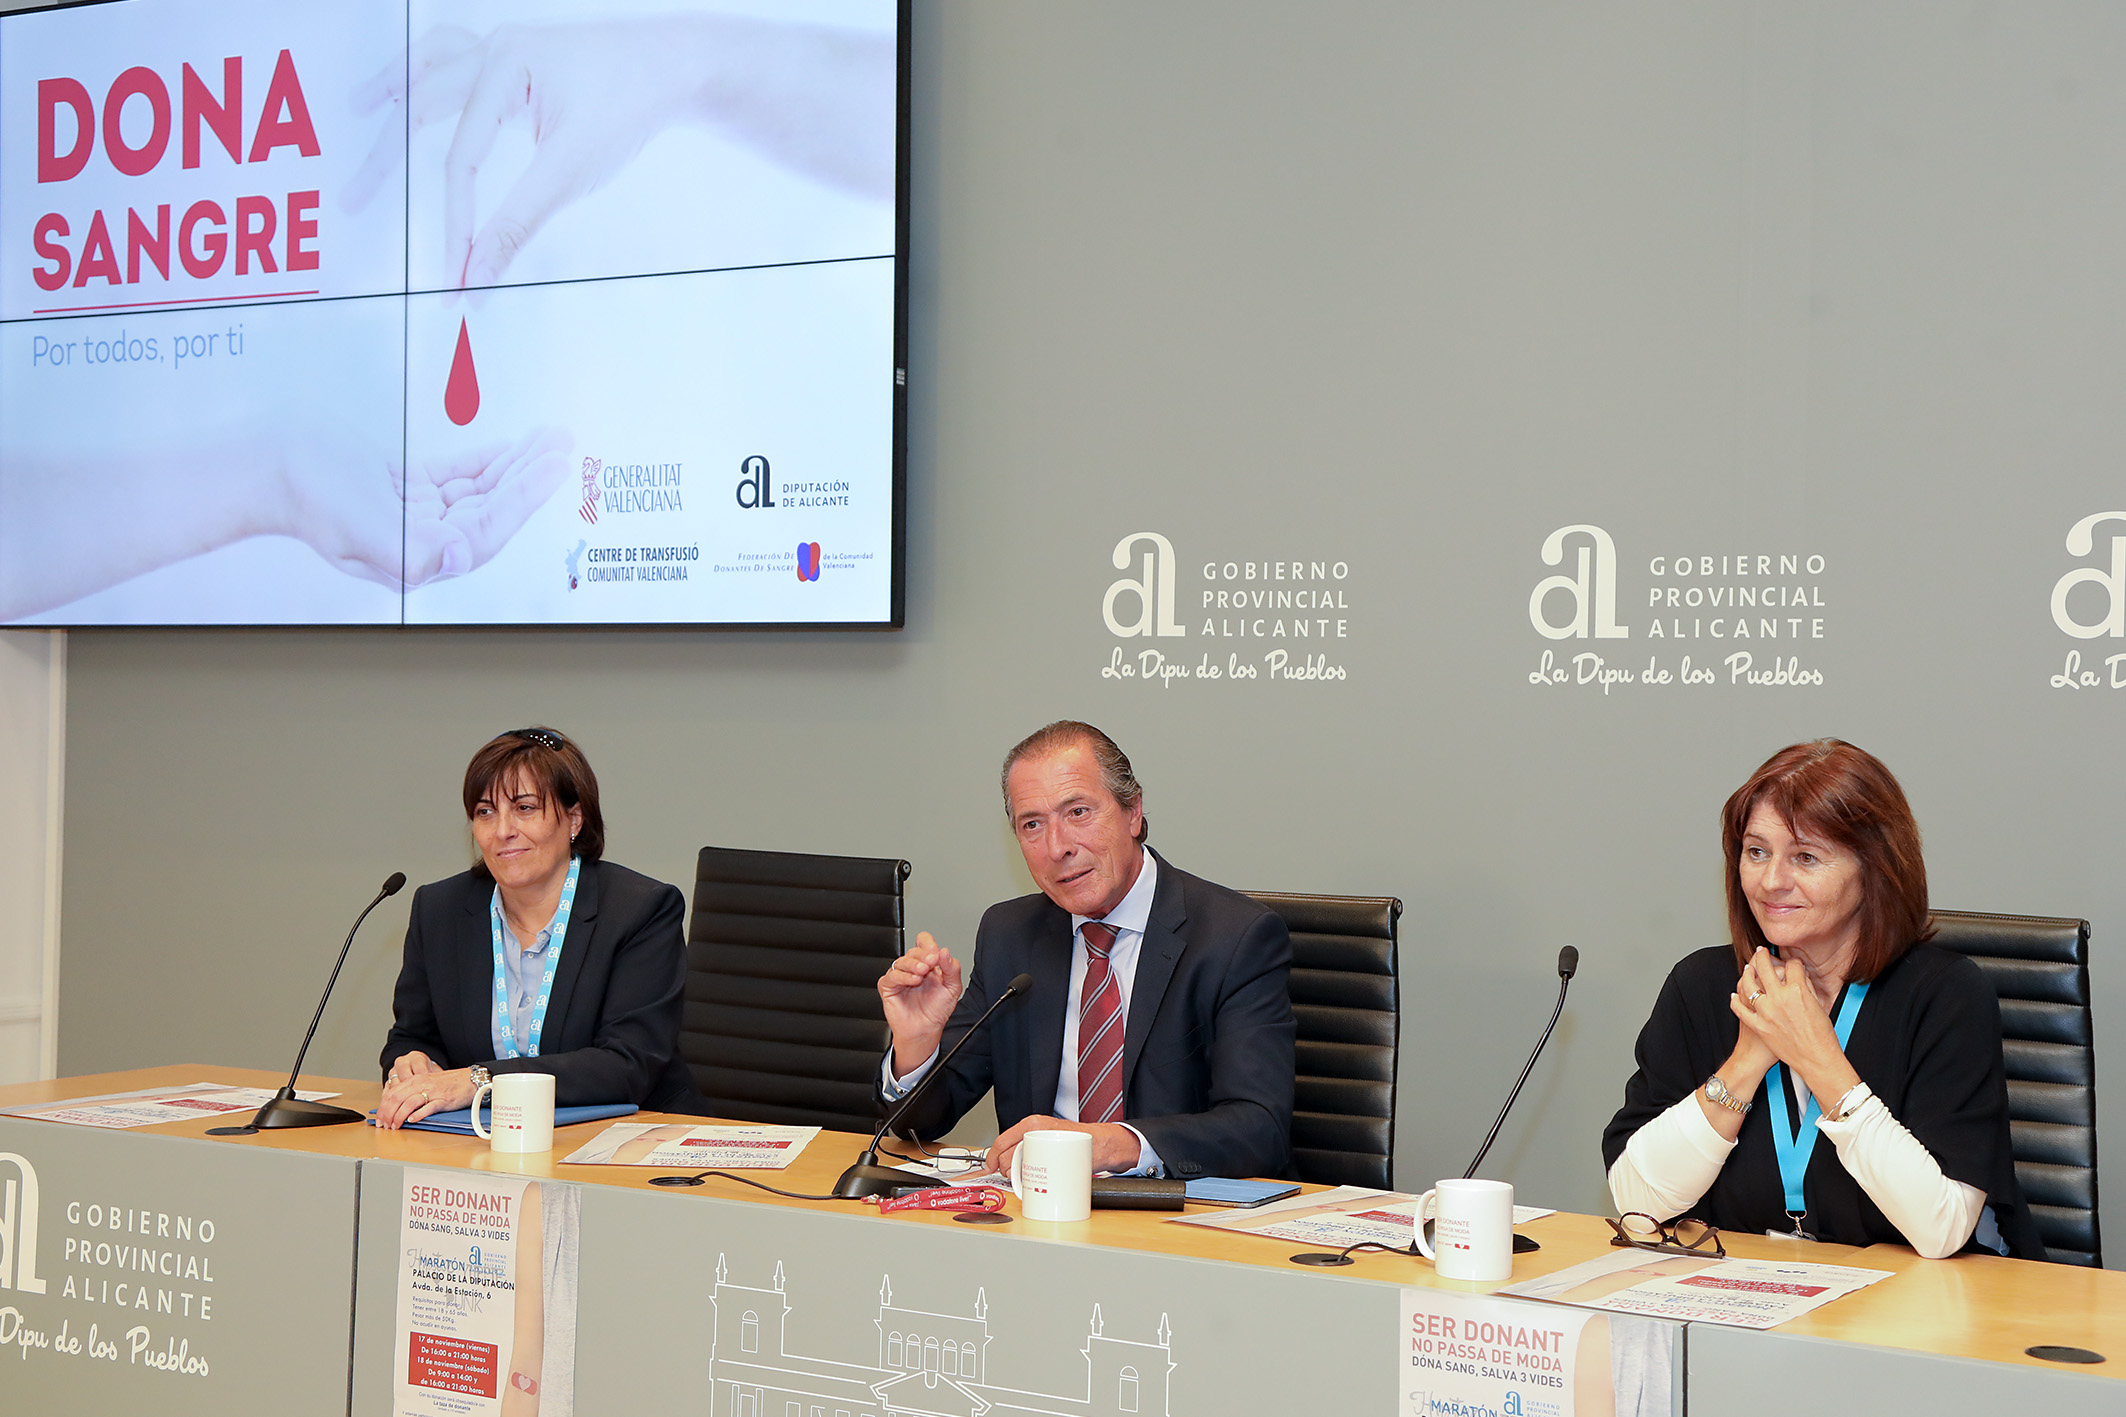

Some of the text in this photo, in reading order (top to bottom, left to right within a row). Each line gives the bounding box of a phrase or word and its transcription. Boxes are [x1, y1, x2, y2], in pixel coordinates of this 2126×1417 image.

[38, 49, 321, 183] DONA
[33, 190, 319, 291] SANGRE
[33, 324, 243, 368] Por todos, por ti
[604, 464, 683, 488] GENERALITAT
[783, 481, 849, 493] DIPUTACIÓN
[604, 490, 682, 512] VALENCIANA
[783, 496, 848, 507] DE ALICANTE
[588, 542, 699, 562] CENTRE DE TRANSFUSIÓ
[587, 566, 687, 582] COMUNITAT VALENCIANA
[1203, 562, 1348, 580] GOBIERNO
[1650, 555, 1825, 576] GOBIERNO
[1203, 590, 1348, 608] PROVINCIAL
[1649, 587, 1825, 607] PROVINCIAL
[1202, 618, 1347, 638] ALICANTE
[1648, 618, 1824, 638] ALICANTE
[1102, 647, 1346, 688] La Dipu de los Pueblos
[1529, 649, 1823, 695] La Dipu de los Pueblos
[2050, 650, 2100, 690] La
[411, 1185, 512, 1213] SER DONANT
[938, 1198, 958, 1206] vodafone
[67, 1202, 215, 1243] GOBIERNO
[410, 1205, 510, 1228] NO PASSA DE MODA
[410, 1219, 510, 1241] DÓNA SANG, SALVA 3 VIDES
[65, 1238, 214, 1282] PROVINCIAL
[420, 1256, 465, 1271] MARATÓN
[413, 1269, 514, 1290] PALACIO DE LA DIPUTACIÓN
[63, 1275, 212, 1321] ALICANTE
[412, 1282, 432, 1291] Avda.
[446, 1286, 452, 1294] la
[455, 1287, 484, 1299] Estación,
[0, 1307, 209, 1376] Dipu de los Pueblos
[1412, 1312, 1564, 1353] SER DONANT
[431, 1348, 446, 1356] 16:00
[453, 1352, 469, 1360] 21:00
[471, 1354, 486, 1363] horas
[435, 1340, 465, 1348] noviembre
[466, 1343, 490, 1354] (viernes)
[1412, 1337, 1562, 1372] NO PASSA DE MODA
[434, 1360, 463, 1370] noviembre
[465, 1364, 489, 1375] (sábado)
[437, 1370, 450, 1378] 9:00
[1412, 1354, 1563, 1388] DÓNA SANG, SALVA 3 VIDES
[452, 1383, 468, 1391] 21:00
[469, 1386, 484, 1394] horas
[1431, 1400, 1497, 1417] MARATÓN
[1527, 1401, 1560, 1410] GOBIERNO
[1527, 1407, 1560, 1416] PROVINCIAL
